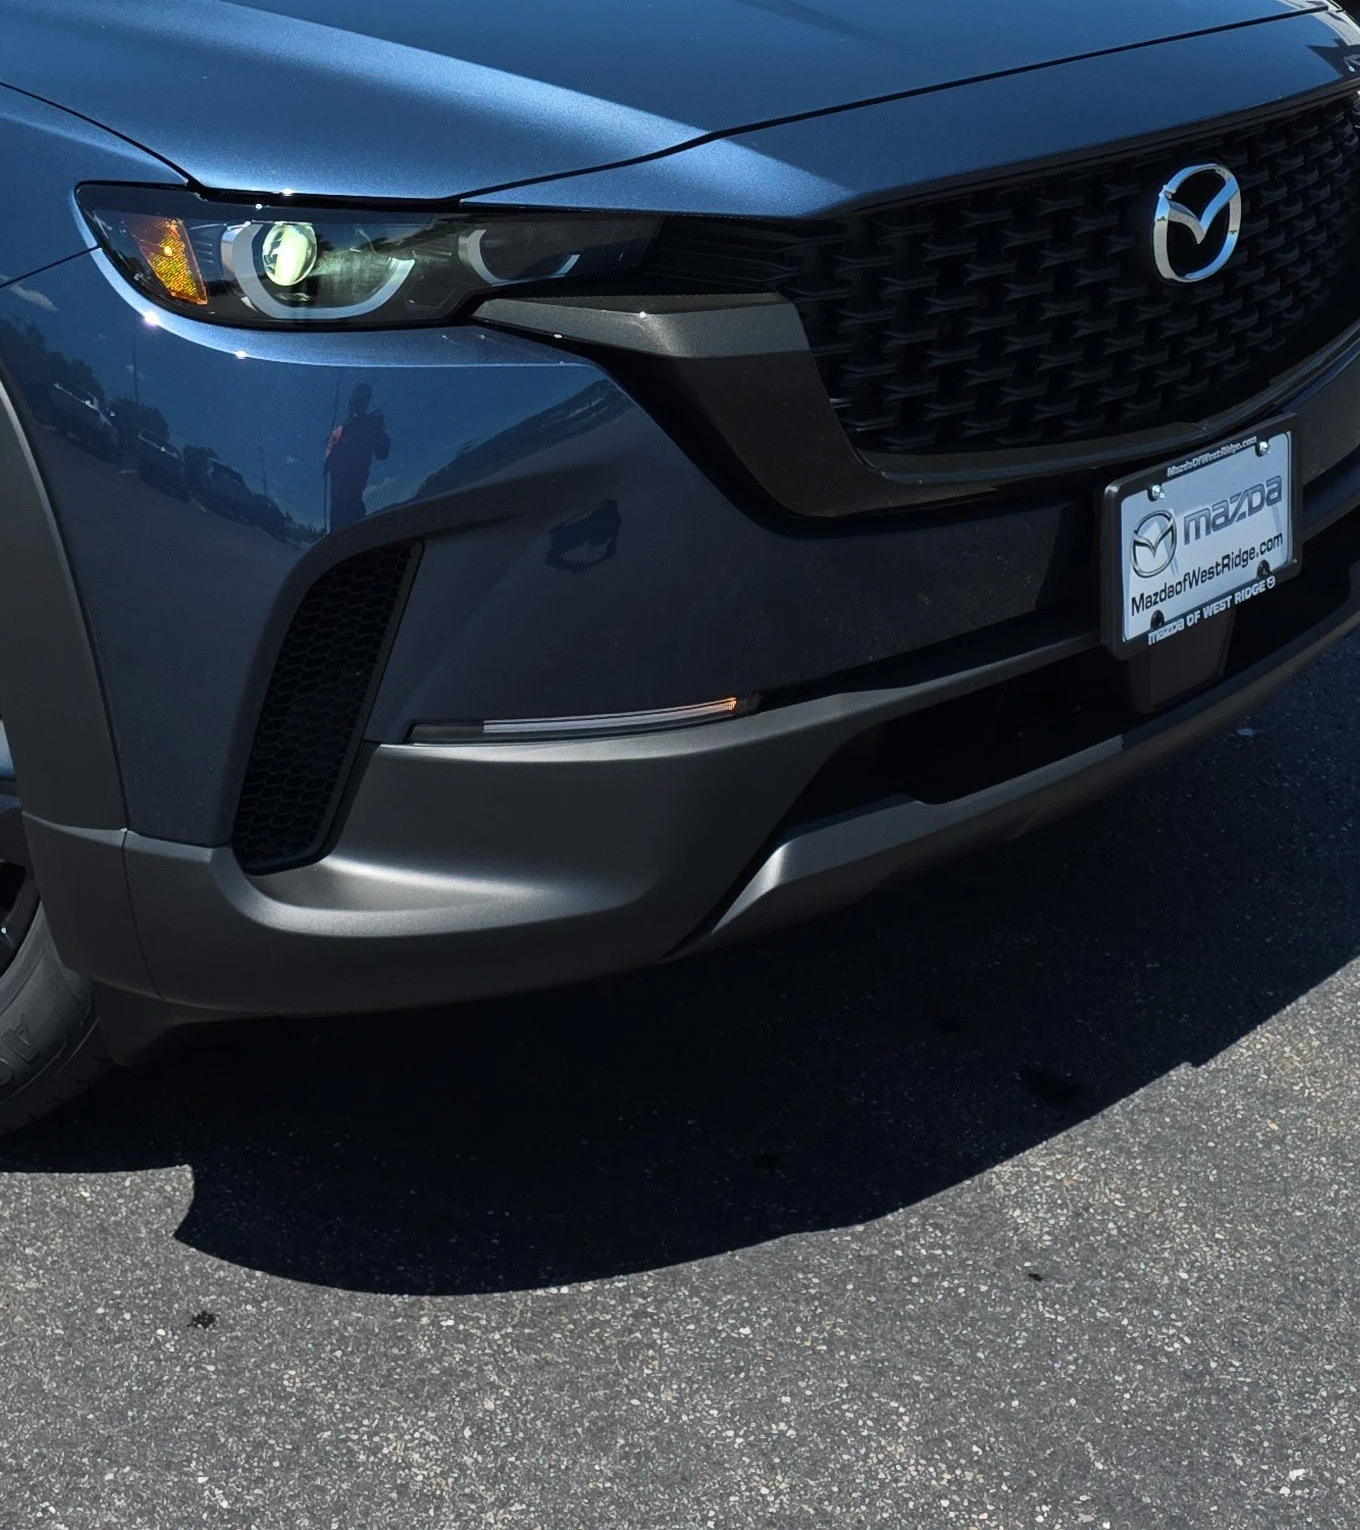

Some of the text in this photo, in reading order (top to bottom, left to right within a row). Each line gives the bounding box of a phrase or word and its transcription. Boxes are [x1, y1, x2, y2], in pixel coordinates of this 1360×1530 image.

[1184, 475, 1283, 546] mazda
[1131, 532, 1284, 616] MazdaofWestRidge.com
[1186, 610, 1201, 628] OF
[1203, 595, 1233, 619] WEST
[1234, 579, 1267, 605] RIDGE
